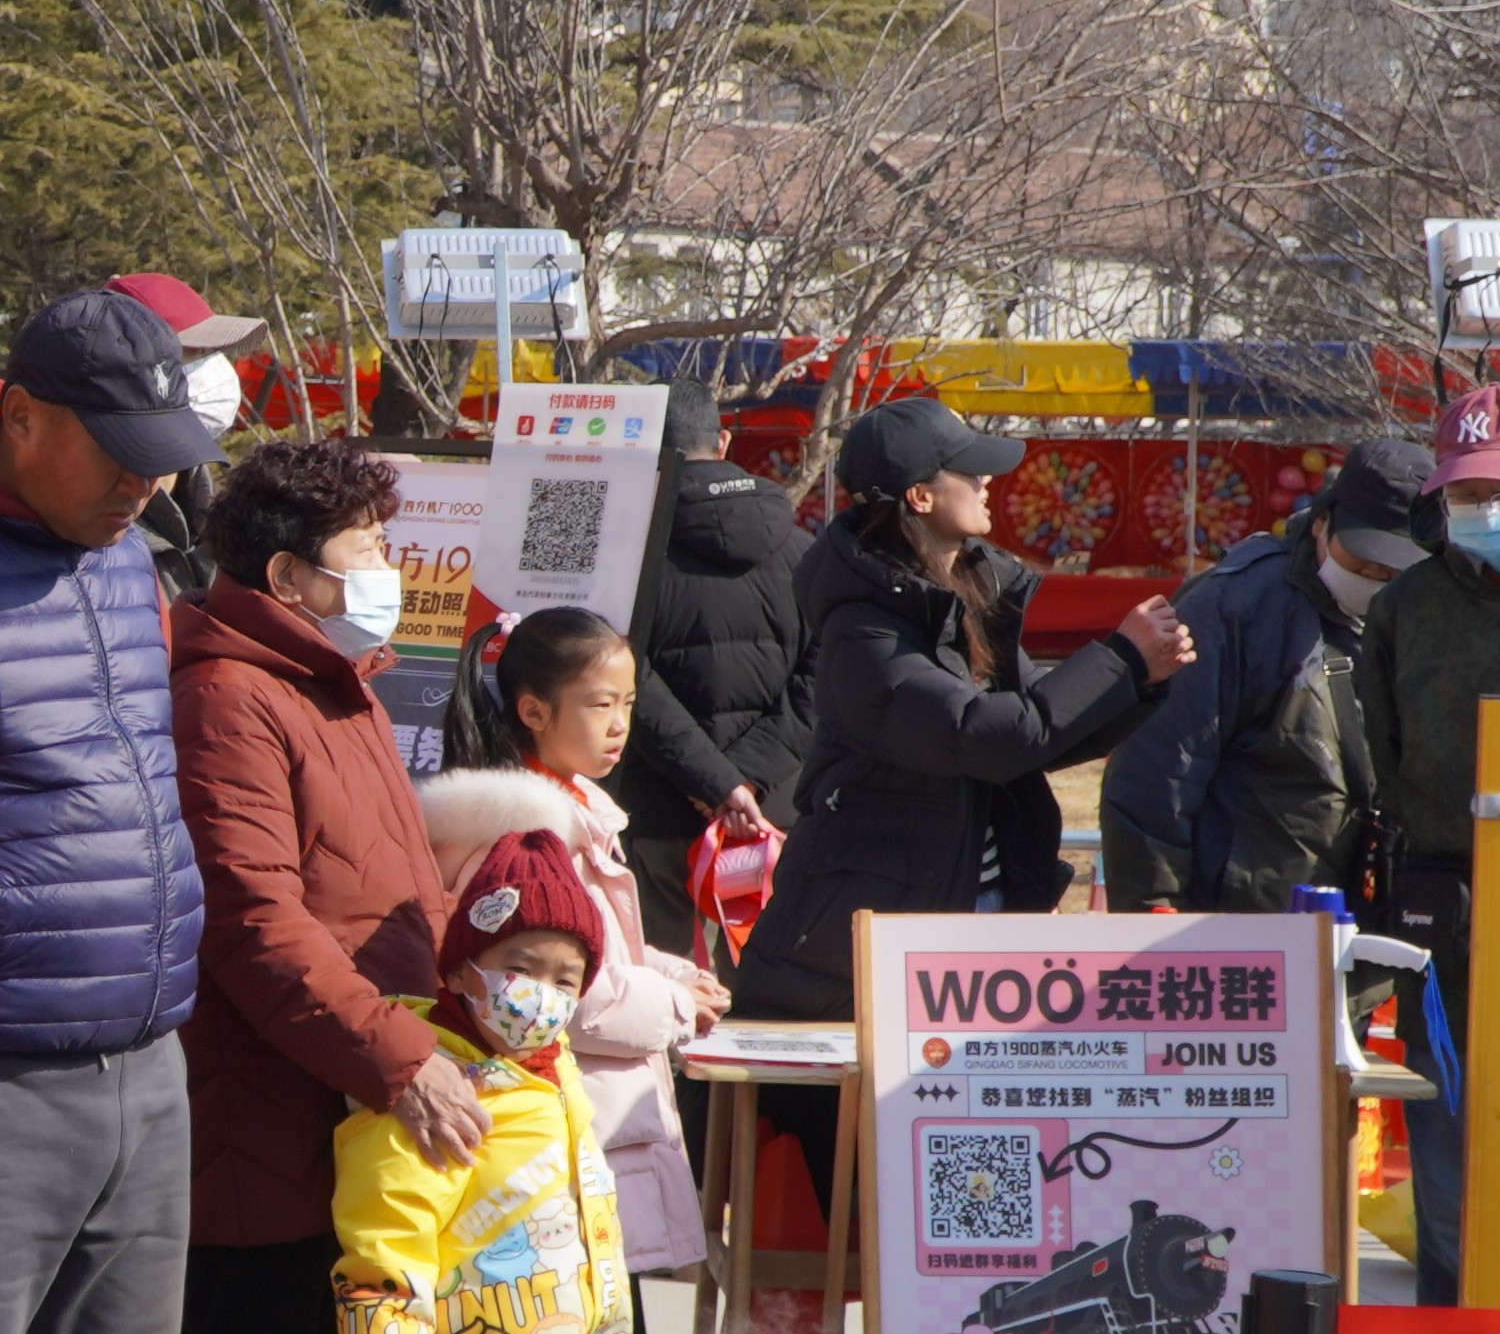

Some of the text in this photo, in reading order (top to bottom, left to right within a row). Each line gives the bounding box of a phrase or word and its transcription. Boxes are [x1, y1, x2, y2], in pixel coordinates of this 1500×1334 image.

[550, 394, 616, 410] 付款请扫码
[1457, 411, 1490, 443] NY
[384, 541, 471, 583] 方19
[400, 590, 467, 616] 活动照
[396, 623, 432, 635] GOOD
[1097, 965, 1276, 1021] 宠粉群
[965, 1041, 1128, 1057] 四方1900蒸汽小火车
[1161, 1042, 1277, 1067] JOIN US
[964, 1060, 1128, 1069] QINGDAO SIFANG LOCOMOTIVE
[981, 1087, 1092, 1107] 恭喜您找到
[1185, 1087, 1275, 1107] 粉丝组织
